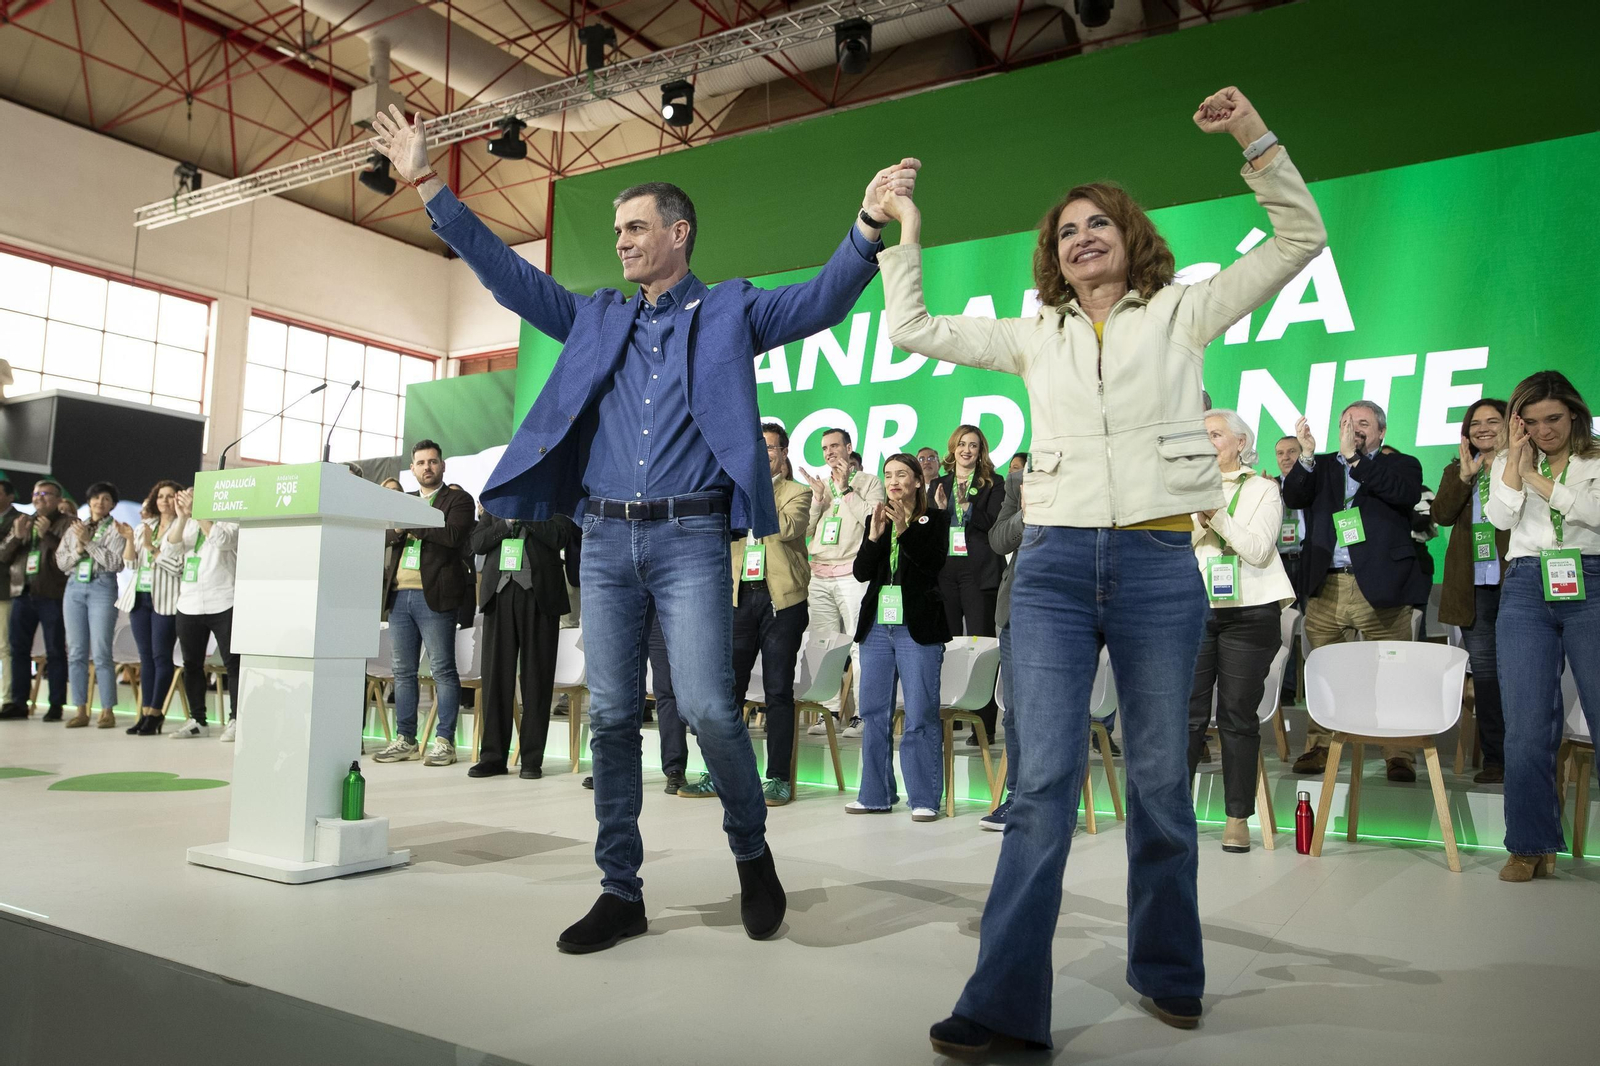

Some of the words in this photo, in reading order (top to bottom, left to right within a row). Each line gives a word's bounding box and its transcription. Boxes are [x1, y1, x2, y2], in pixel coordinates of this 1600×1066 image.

[760, 403, 918, 486] OR
[214, 476, 256, 489] ANDALUCÍA
[276, 481, 298, 494] PSOE
[213, 491, 229, 500] POR
[1475, 531, 1483, 541] 15
